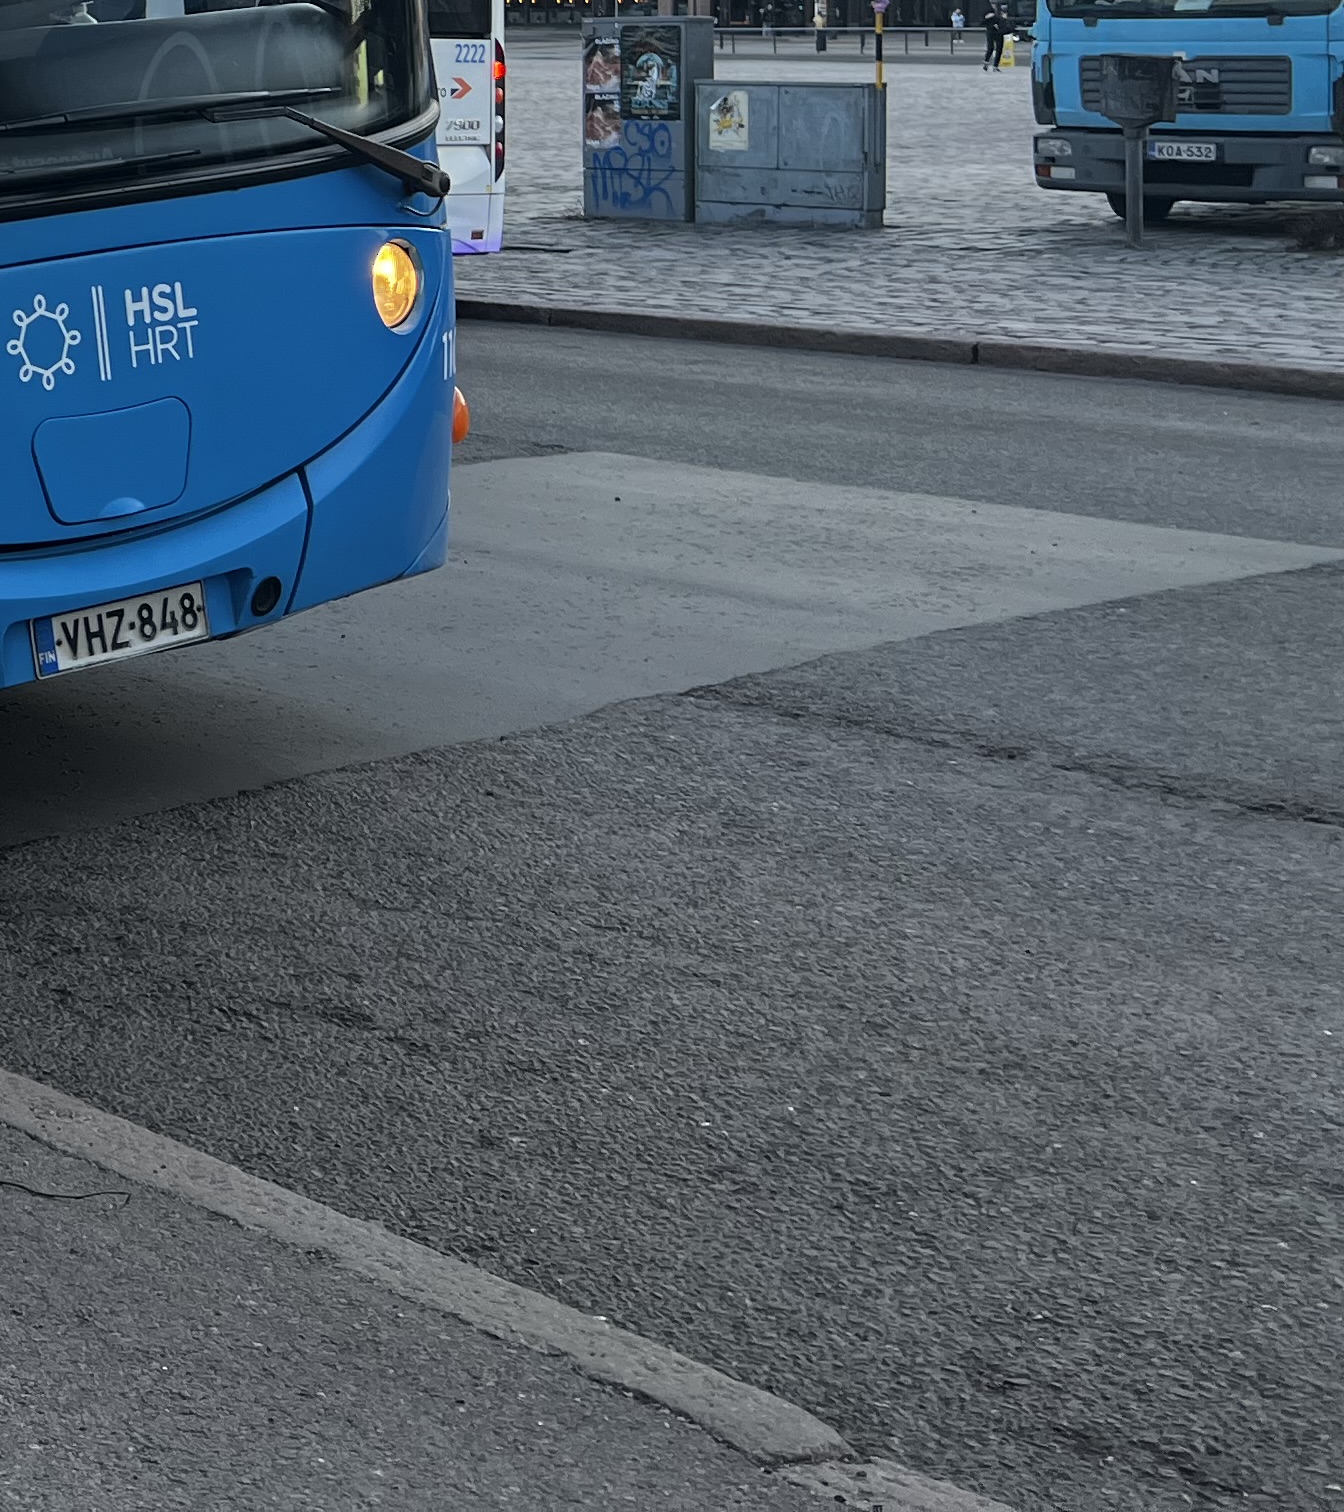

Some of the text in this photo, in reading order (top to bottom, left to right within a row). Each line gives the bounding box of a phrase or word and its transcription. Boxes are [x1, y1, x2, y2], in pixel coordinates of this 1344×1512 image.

[455, 43, 486, 64] 2222
[124, 281, 198, 327] HSL
[128, 319, 199, 368] HRT
[60, 591, 200, 661] VHZ-848
[39, 650, 57, 666] FIN
